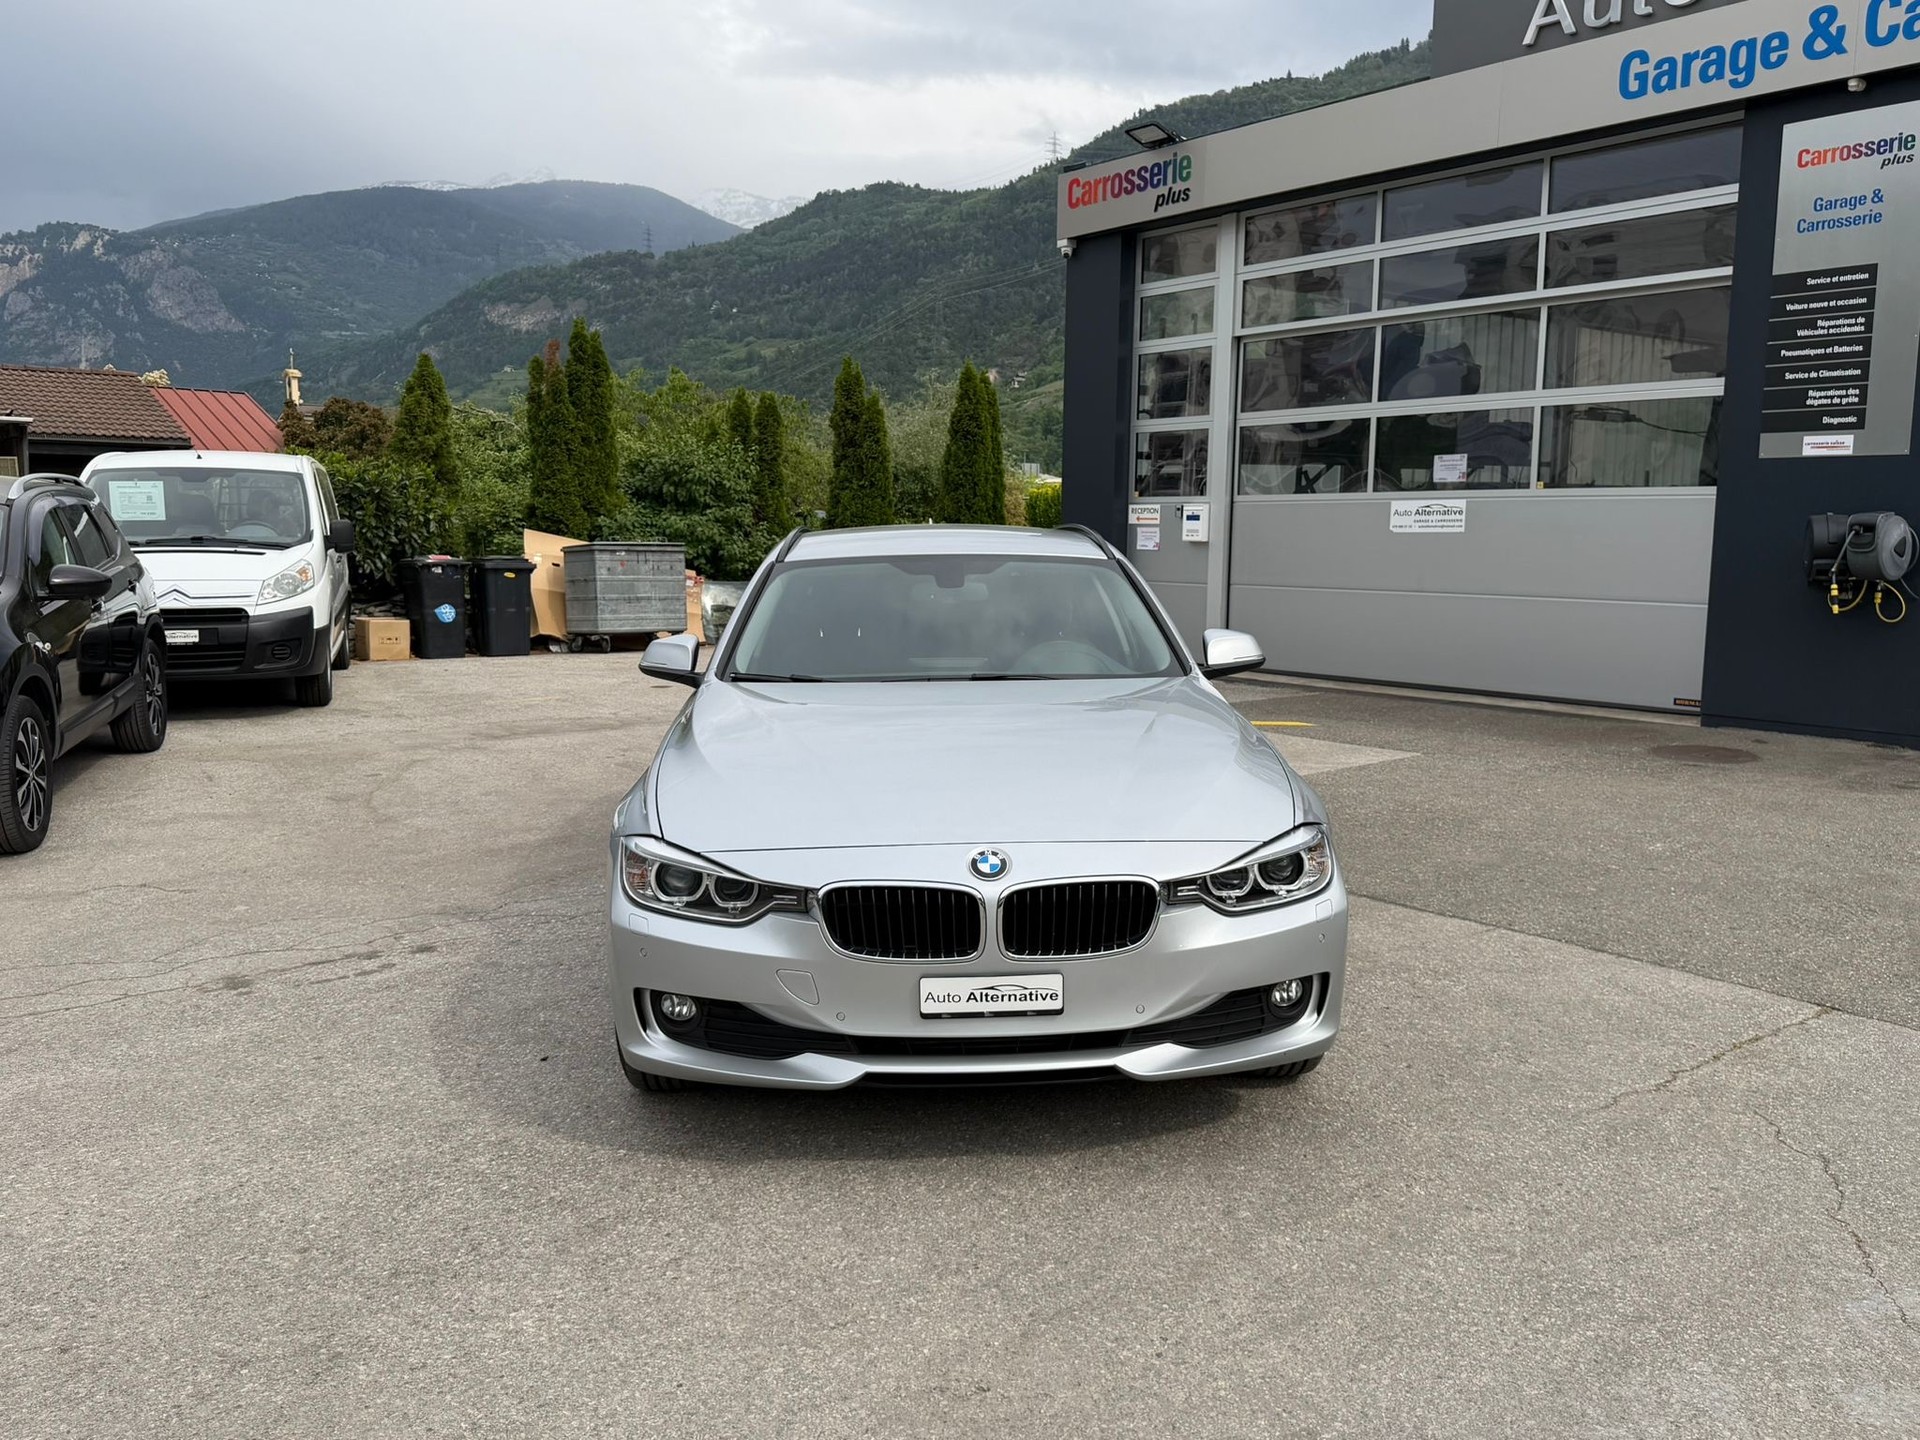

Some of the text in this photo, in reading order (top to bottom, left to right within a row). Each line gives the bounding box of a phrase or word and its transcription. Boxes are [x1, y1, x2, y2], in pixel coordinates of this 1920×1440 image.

[1619, 31, 1790, 100] Garage
[1802, 4, 1848, 60] &
[1797, 132, 1916, 169] Carrosserie
[1880, 153, 1915, 170] plus
[1067, 152, 1192, 209] Carrosserie
[1153, 186, 1191, 213] plus
[1813, 188, 1884, 212] Garage &
[1797, 209, 1883, 234] Carrosserie
[1806, 277, 1831, 285] Service
[1839, 272, 1869, 281] entretien
[1786, 302, 1808, 311] Voiture
[1808, 301, 1828, 309] neuve
[1837, 296, 1867, 306] occasion
[1817, 317, 1855, 328] Réparations
[1797, 324, 1865, 337] Véhicules accidentés
[1780, 343, 1863, 357] Pneumatiques et Batteries
[1785, 367, 1861, 380] Service de Climatisation
[1808, 387, 1860, 398] Réparations des
[1832, 396, 1841, 404] de
[1822, 415, 1858, 425] Diagnostic
[1392, 508, 1464, 517] Auto Alternative
[924, 990, 1060, 1004] Auto Alternative
